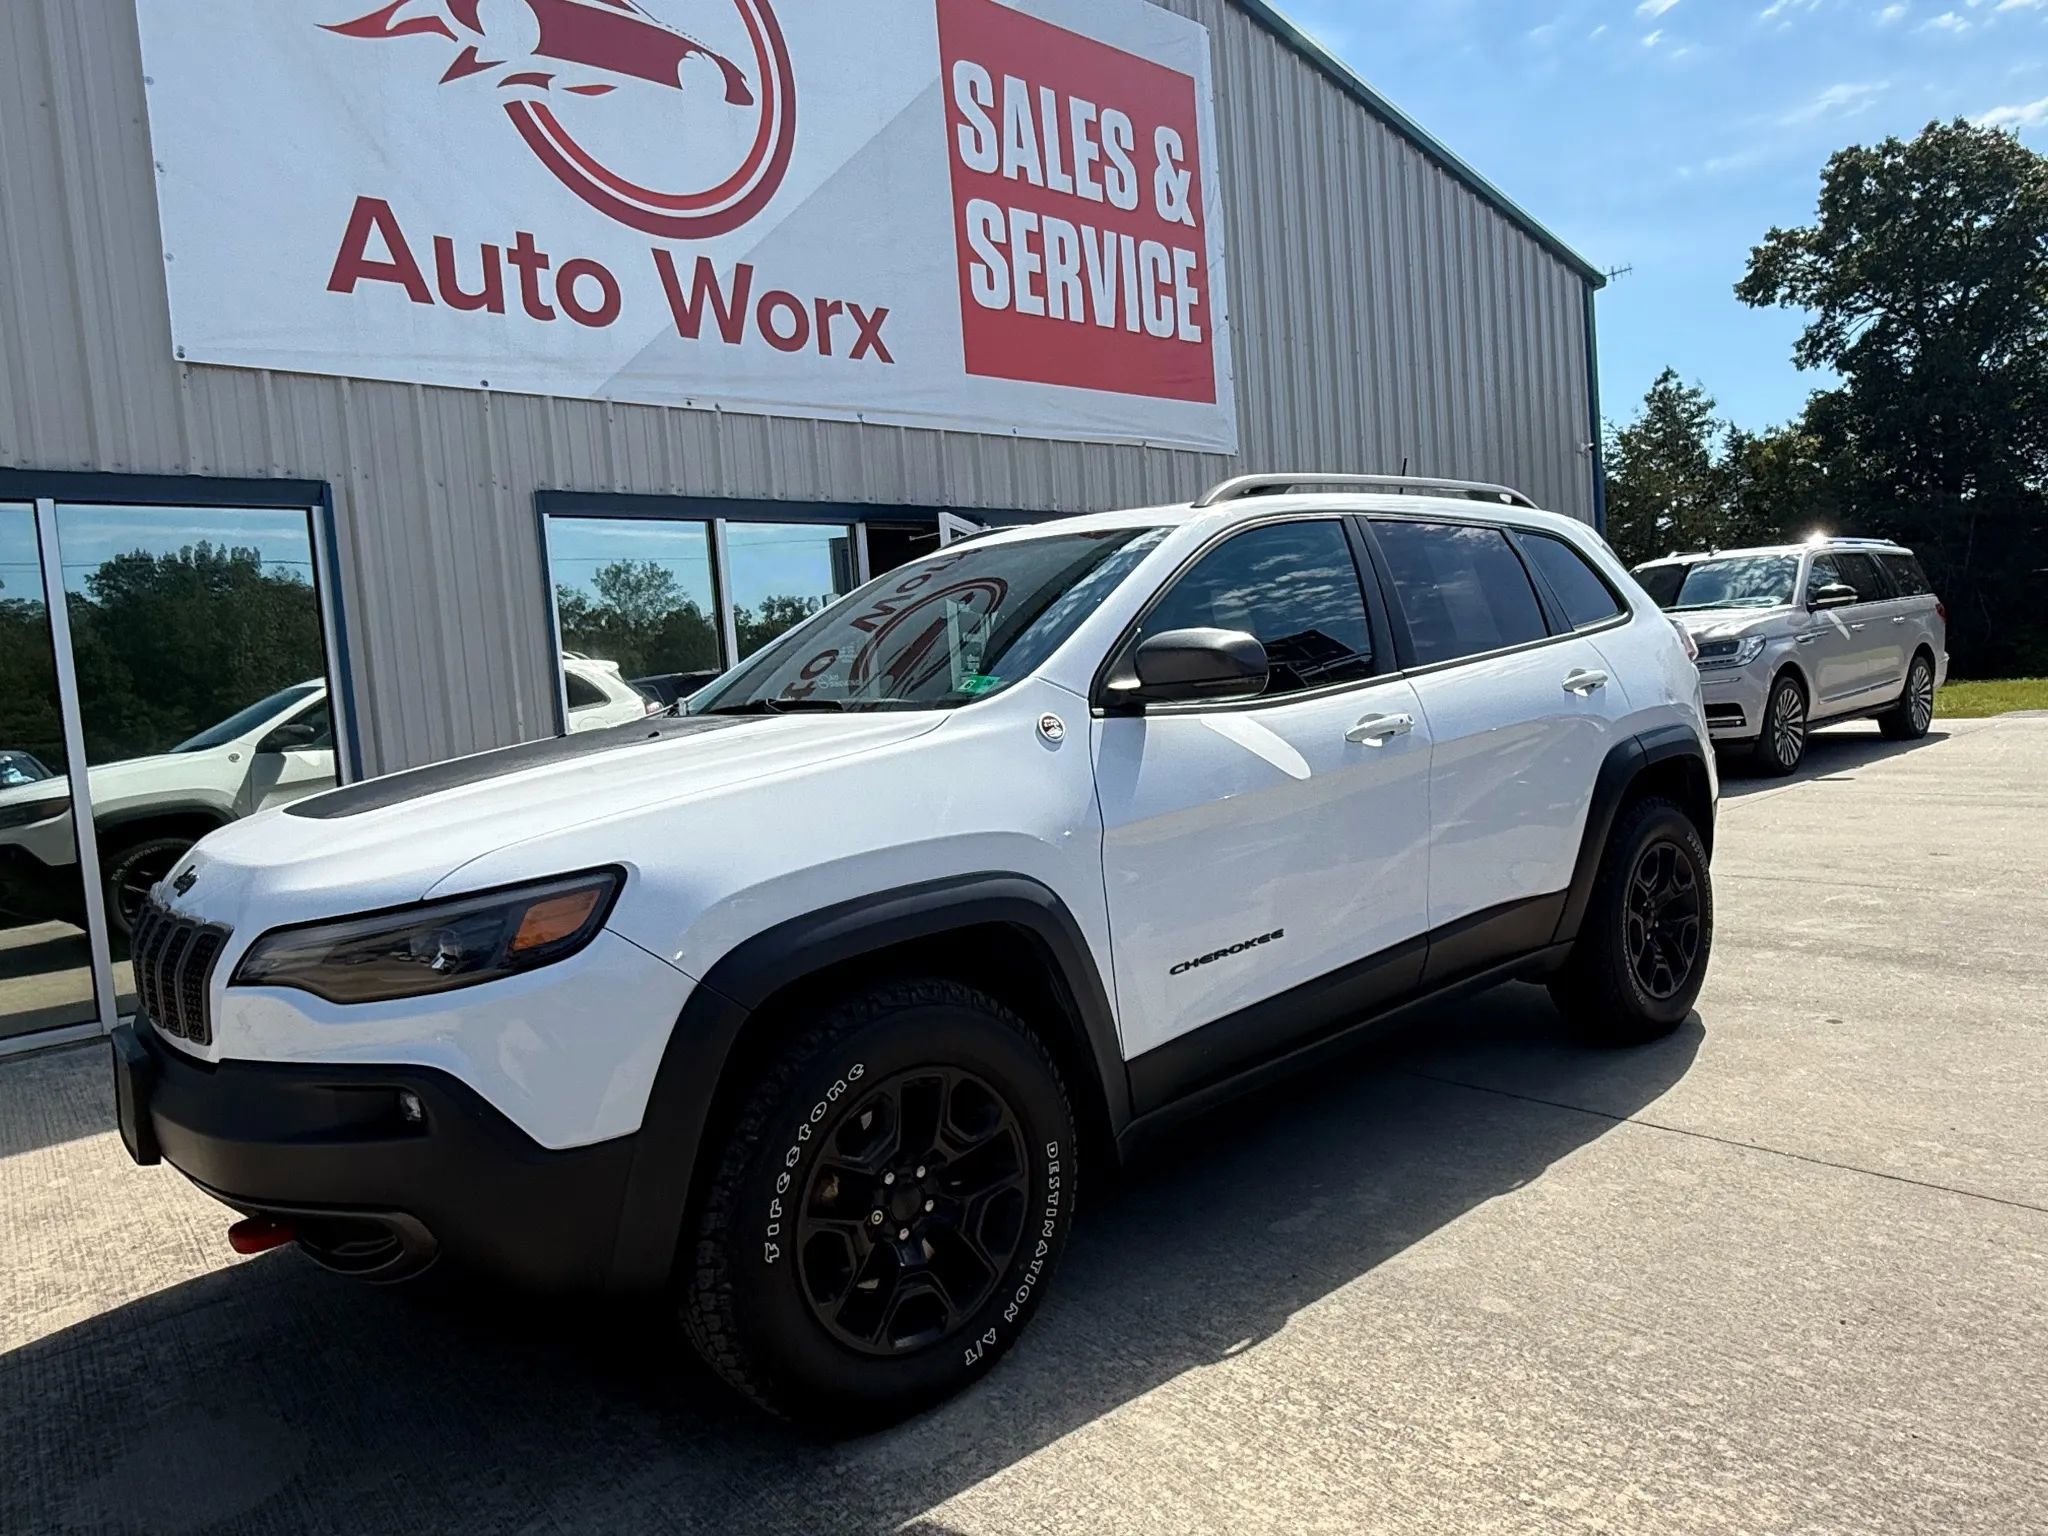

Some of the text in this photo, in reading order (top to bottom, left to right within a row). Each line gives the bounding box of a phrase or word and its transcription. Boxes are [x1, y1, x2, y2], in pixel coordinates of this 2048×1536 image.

[953, 60, 1196, 227] SALES &
[326, 196, 894, 363] Auto Worx
[966, 199, 1202, 342] SERVICE
[1169, 928, 1284, 975] CHEROKEE
[965, 1141, 1060, 1365] DESTINATION A/T
